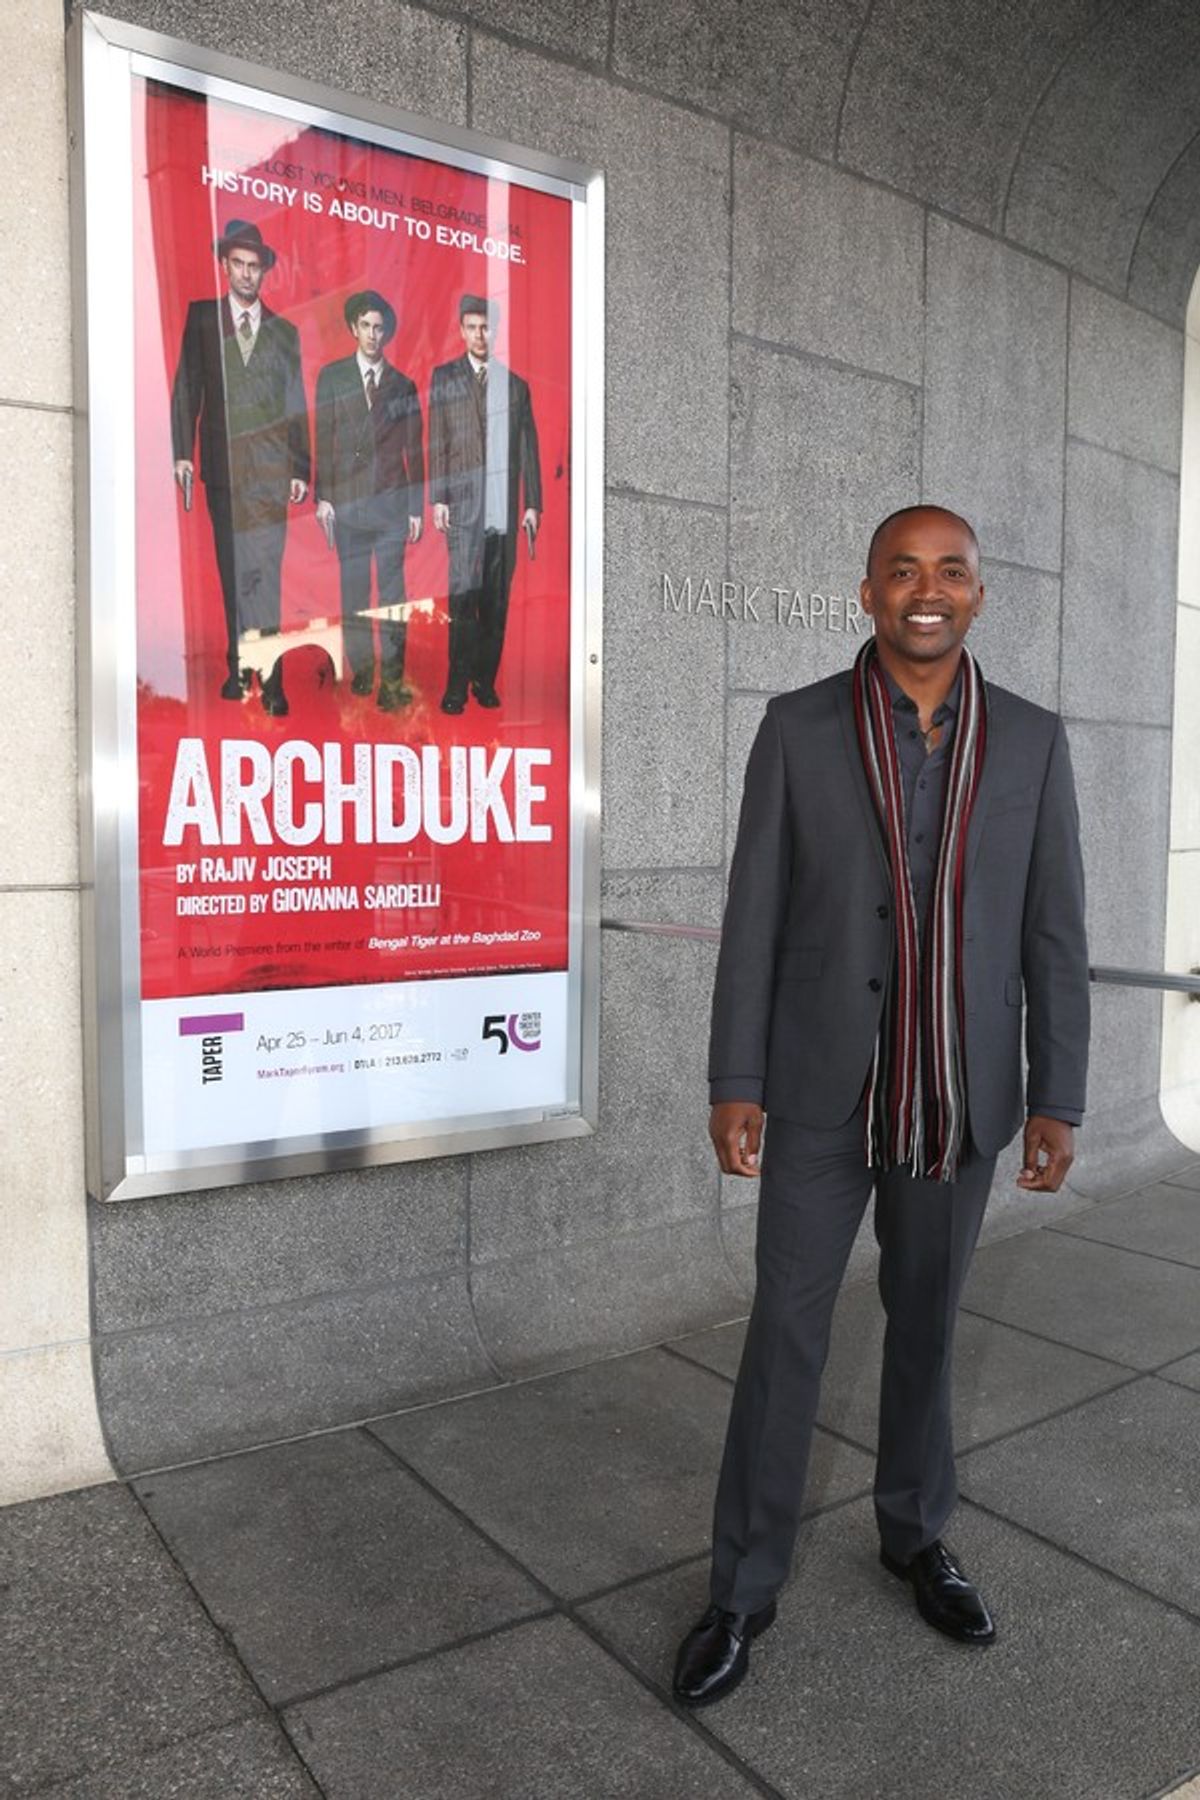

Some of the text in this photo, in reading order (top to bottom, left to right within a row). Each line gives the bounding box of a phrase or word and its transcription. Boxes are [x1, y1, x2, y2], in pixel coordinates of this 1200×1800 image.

[201, 165, 526, 265] HISTORY IS ABOUT TO EXPLODE.
[661, 573, 760, 622] MARK
[771, 587, 861, 634] TAPER
[162, 738, 552, 847] ARCHDUKE
[176, 856, 332, 883] BY RAJIV JOSEPH
[176, 883, 441, 916] DIRECTED BY GIOVANNA SARDELLI
[177, 947, 188, 959] A
[190, 944, 222, 958] World
[276, 941, 302, 954] from
[368, 936, 408, 951] Bengal
[411, 934, 438, 950] Tiger
[440, 933, 451, 946] at
[452, 932, 470, 946] the
[472, 929, 518, 945] Baghdad
[520, 929, 542, 942] Zoo
[256, 1034, 281, 1053] Apr
[286, 1031, 306, 1049] 25
[322, 1029, 348, 1045] Jun
[369, 1022, 403, 1041] 2017
[202, 1035, 224, 1085] TAPER
